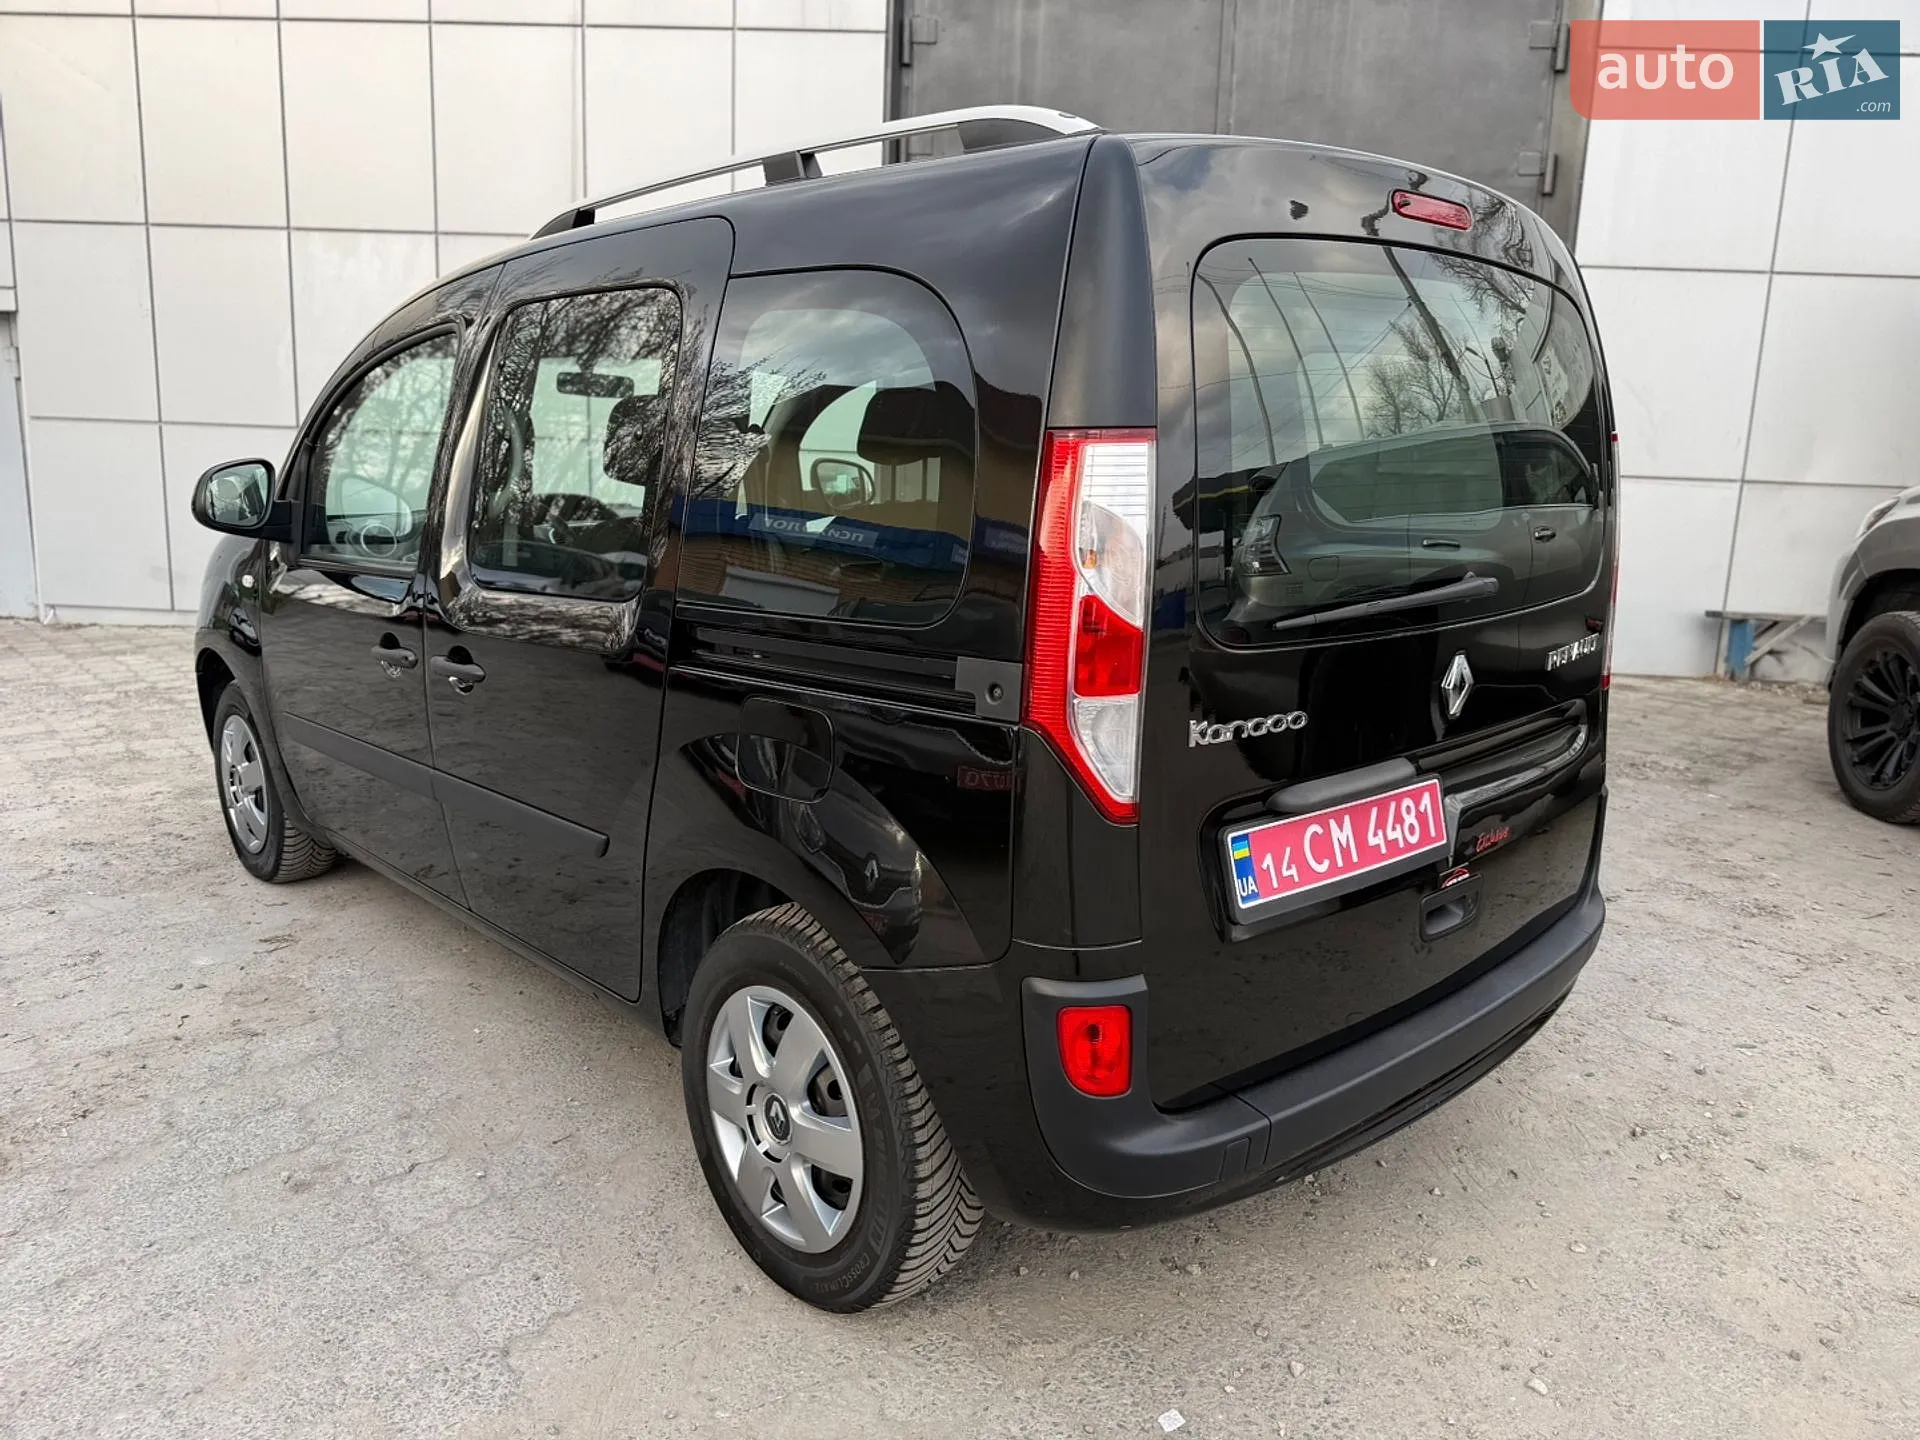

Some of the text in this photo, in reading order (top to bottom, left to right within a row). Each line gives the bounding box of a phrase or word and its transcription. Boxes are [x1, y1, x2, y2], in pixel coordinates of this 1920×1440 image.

[1261, 846, 1299, 889] 14
[1303, 814, 1359, 873] CM
[1367, 791, 1437, 855] 4481
[1236, 875, 1258, 898] UA
